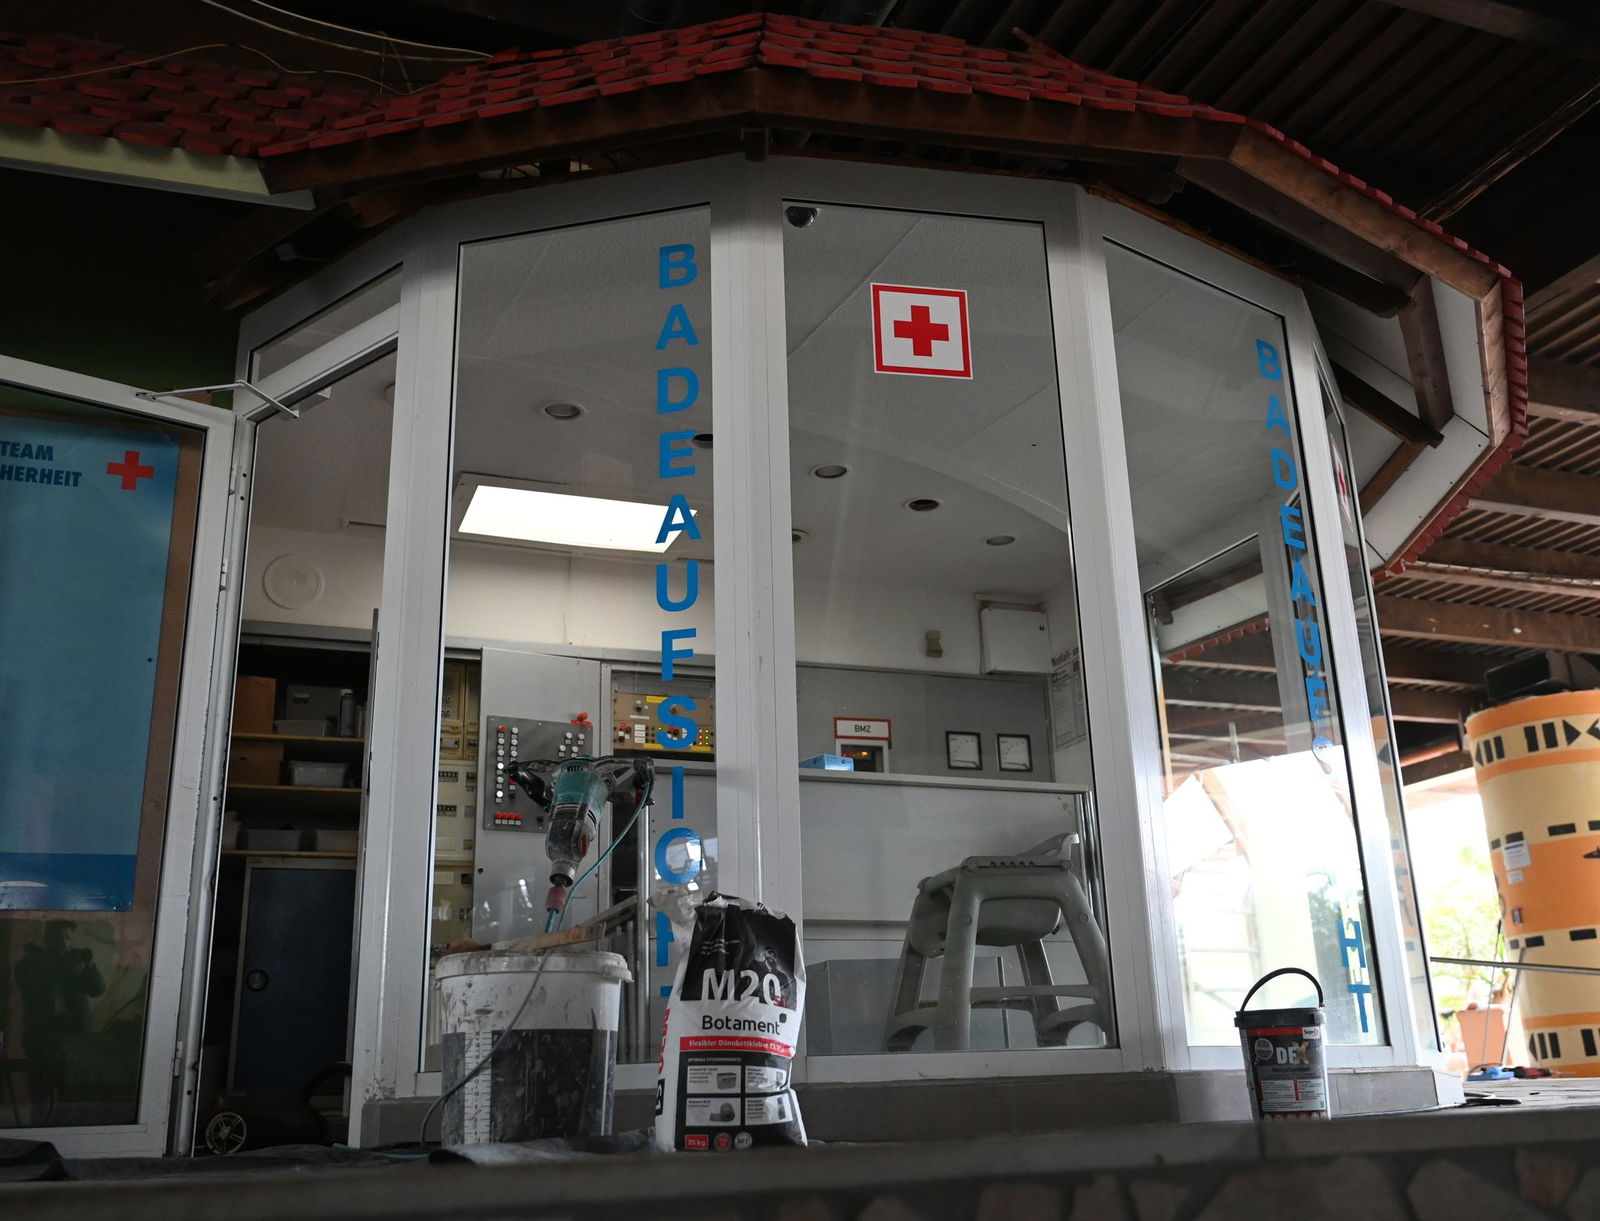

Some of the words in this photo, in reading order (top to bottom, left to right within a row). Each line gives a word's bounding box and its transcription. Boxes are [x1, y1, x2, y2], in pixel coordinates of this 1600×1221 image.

[0, 440, 54, 461] TEAM
[854, 724, 871, 733] BMZ
[702, 1014, 780, 1036] Botament
